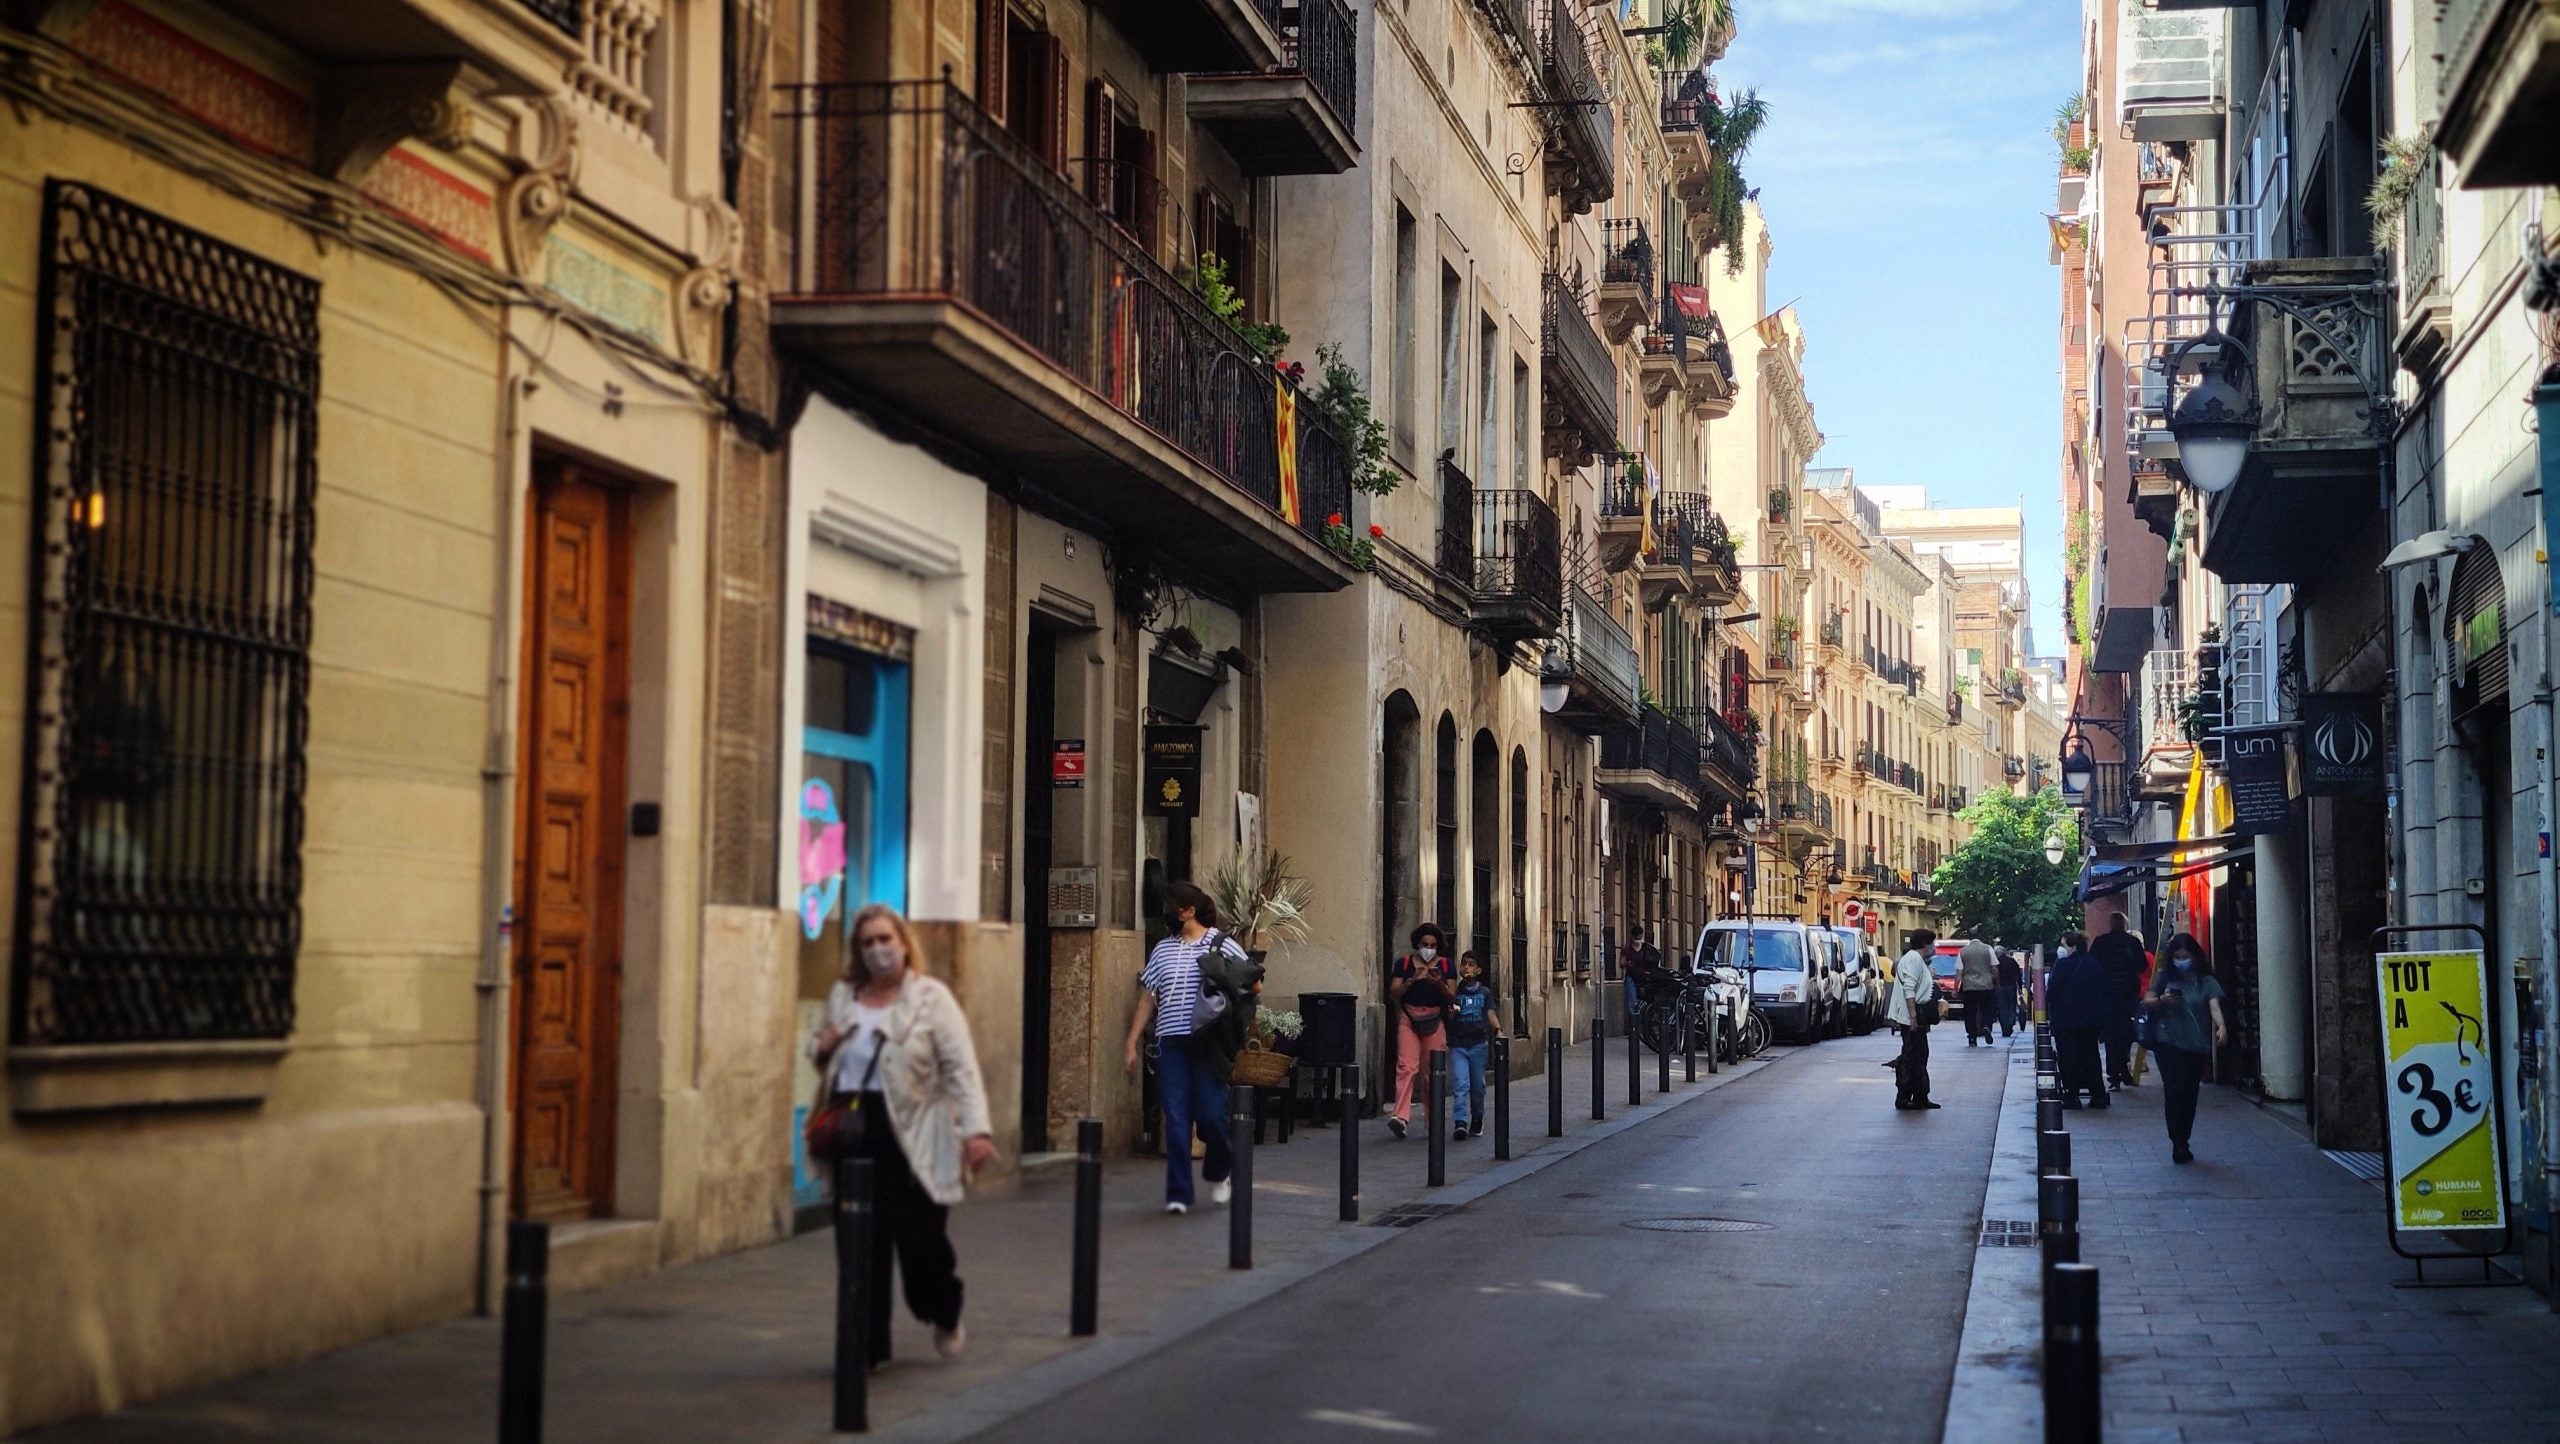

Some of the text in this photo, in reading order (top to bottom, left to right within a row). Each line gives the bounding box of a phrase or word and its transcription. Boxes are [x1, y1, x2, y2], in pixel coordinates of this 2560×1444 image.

[2388, 960, 2432, 993] TOT
[2394, 998, 2409, 1029] A
[2435, 1180, 2482, 1191] HUMANA
